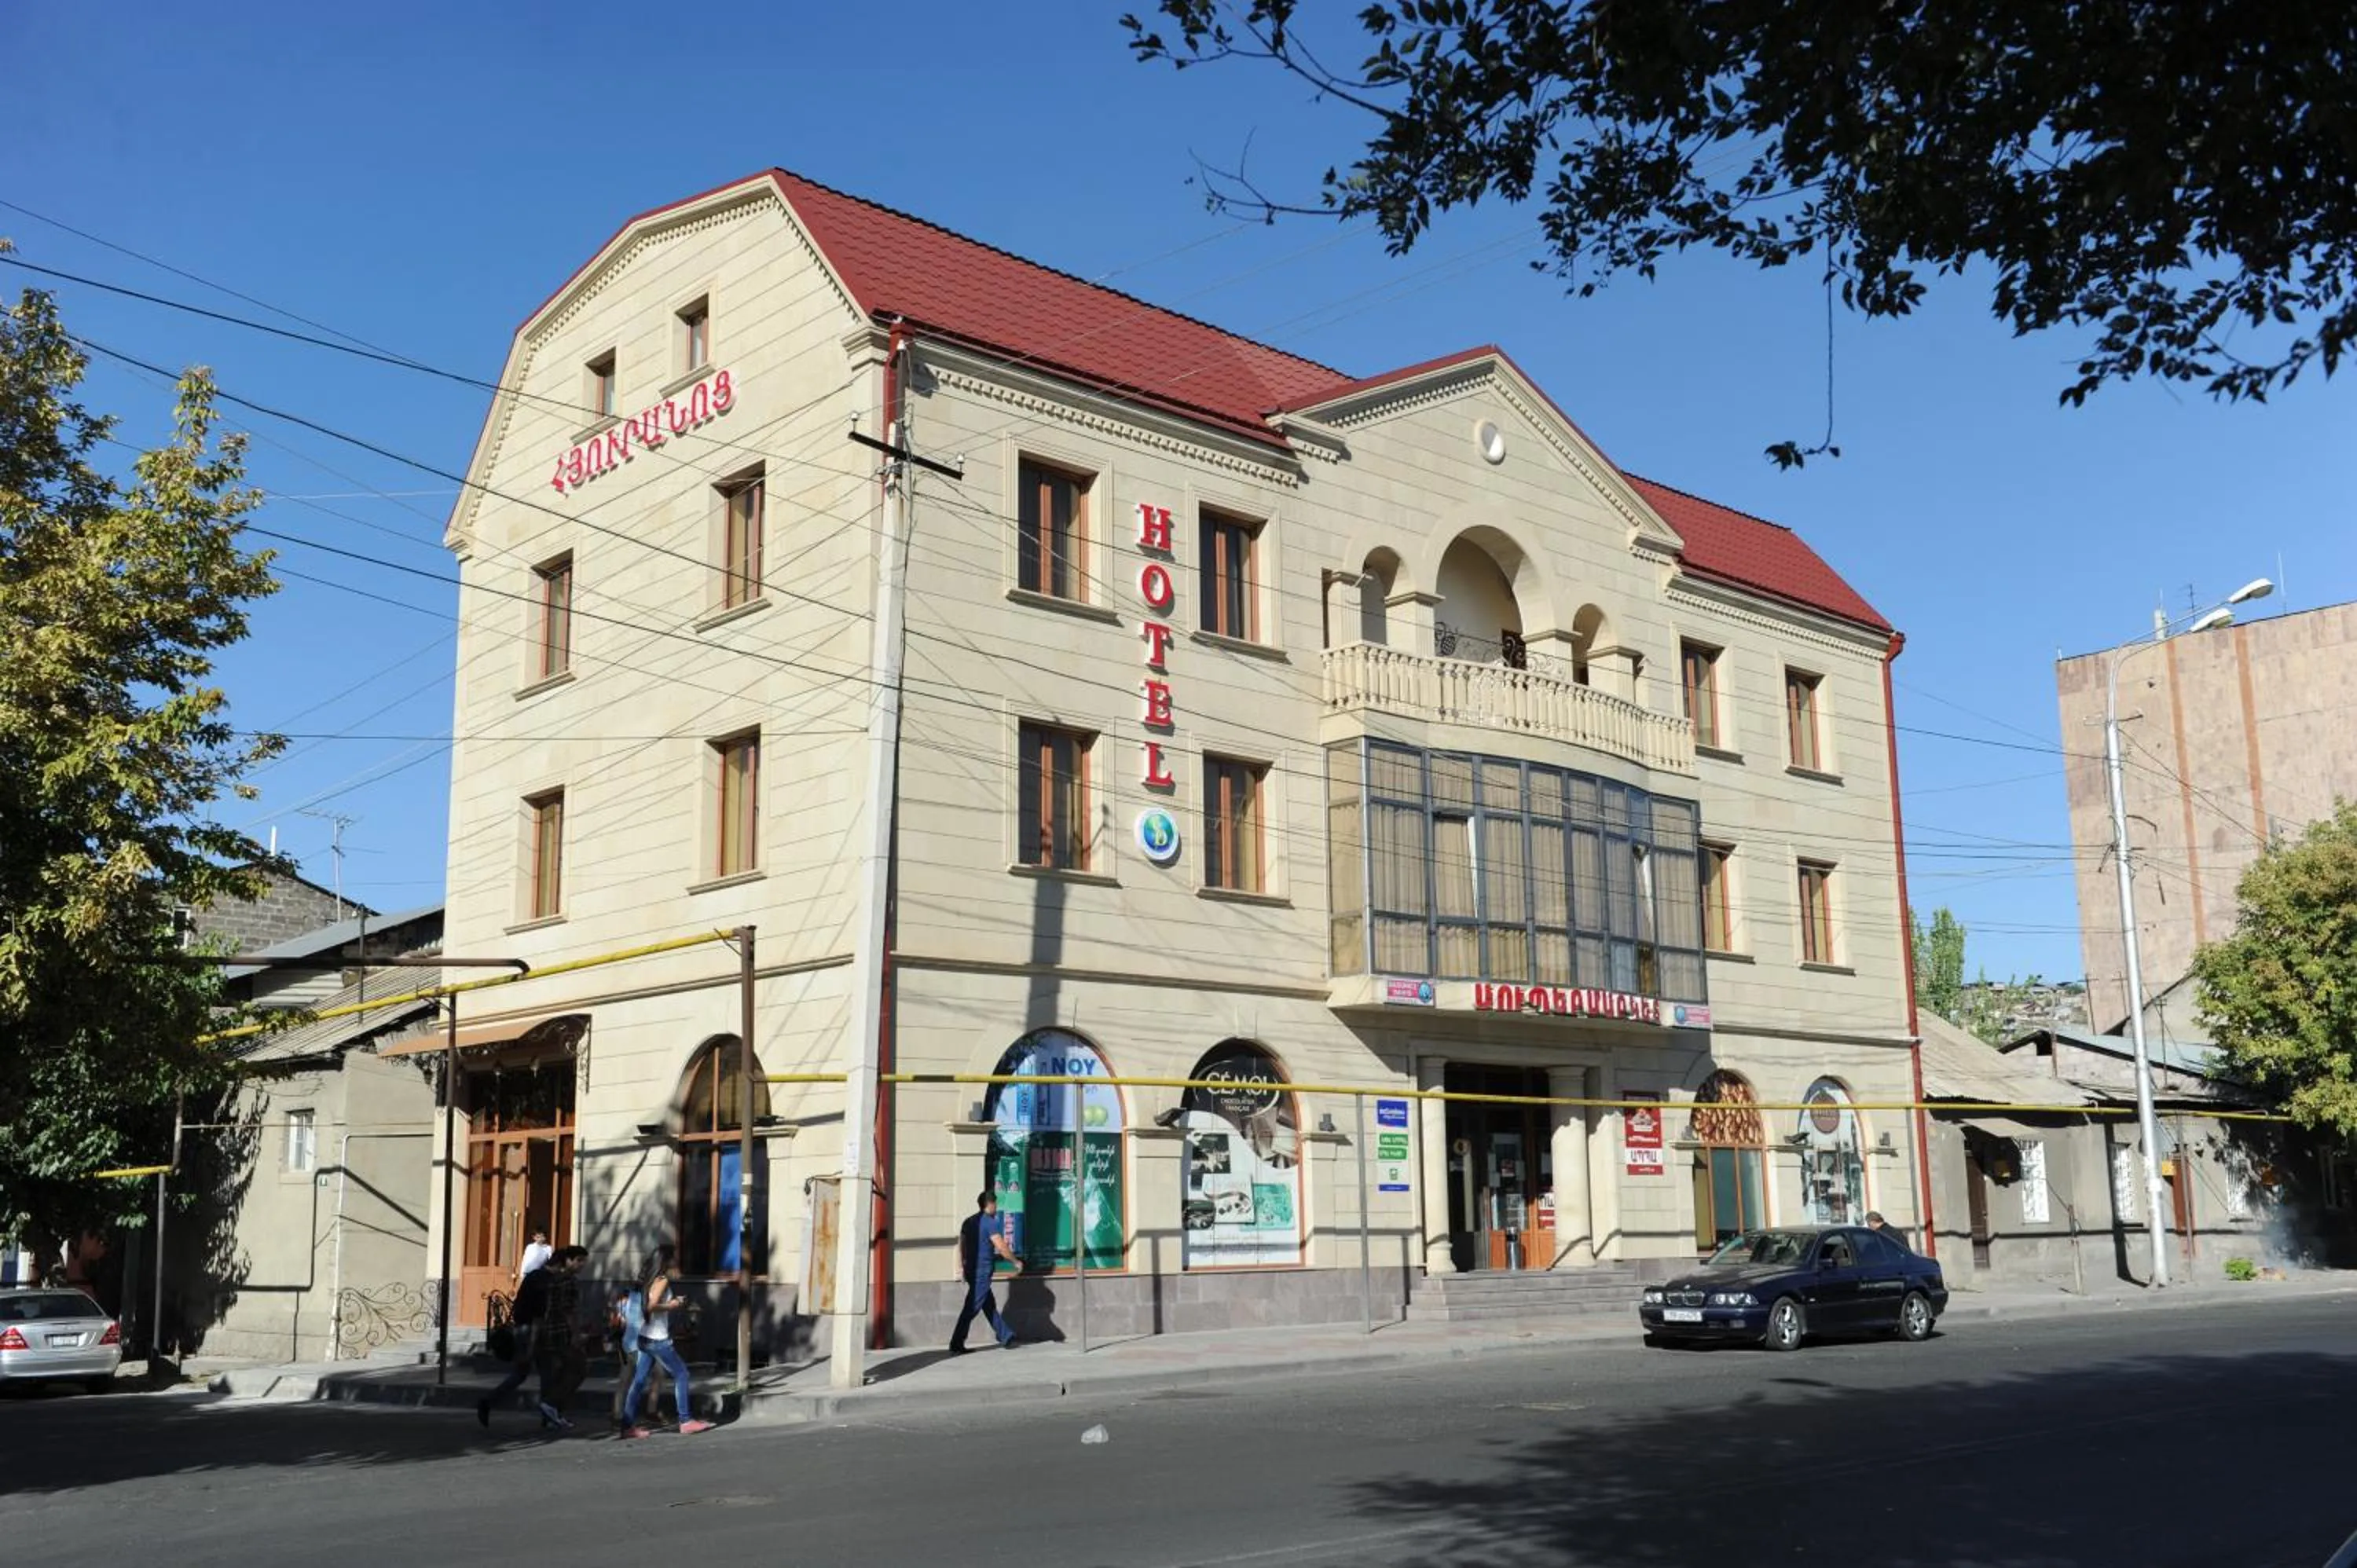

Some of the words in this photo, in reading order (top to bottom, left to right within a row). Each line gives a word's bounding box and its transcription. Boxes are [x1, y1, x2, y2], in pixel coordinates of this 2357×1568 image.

[550, 369, 732, 493] ՀՅՈՒՐԱՆՈՑ
[1138, 502, 1174, 786] HOTEL
[1050, 1057, 1097, 1076] NOY
[1205, 1070, 1269, 1097] CÉMOI
